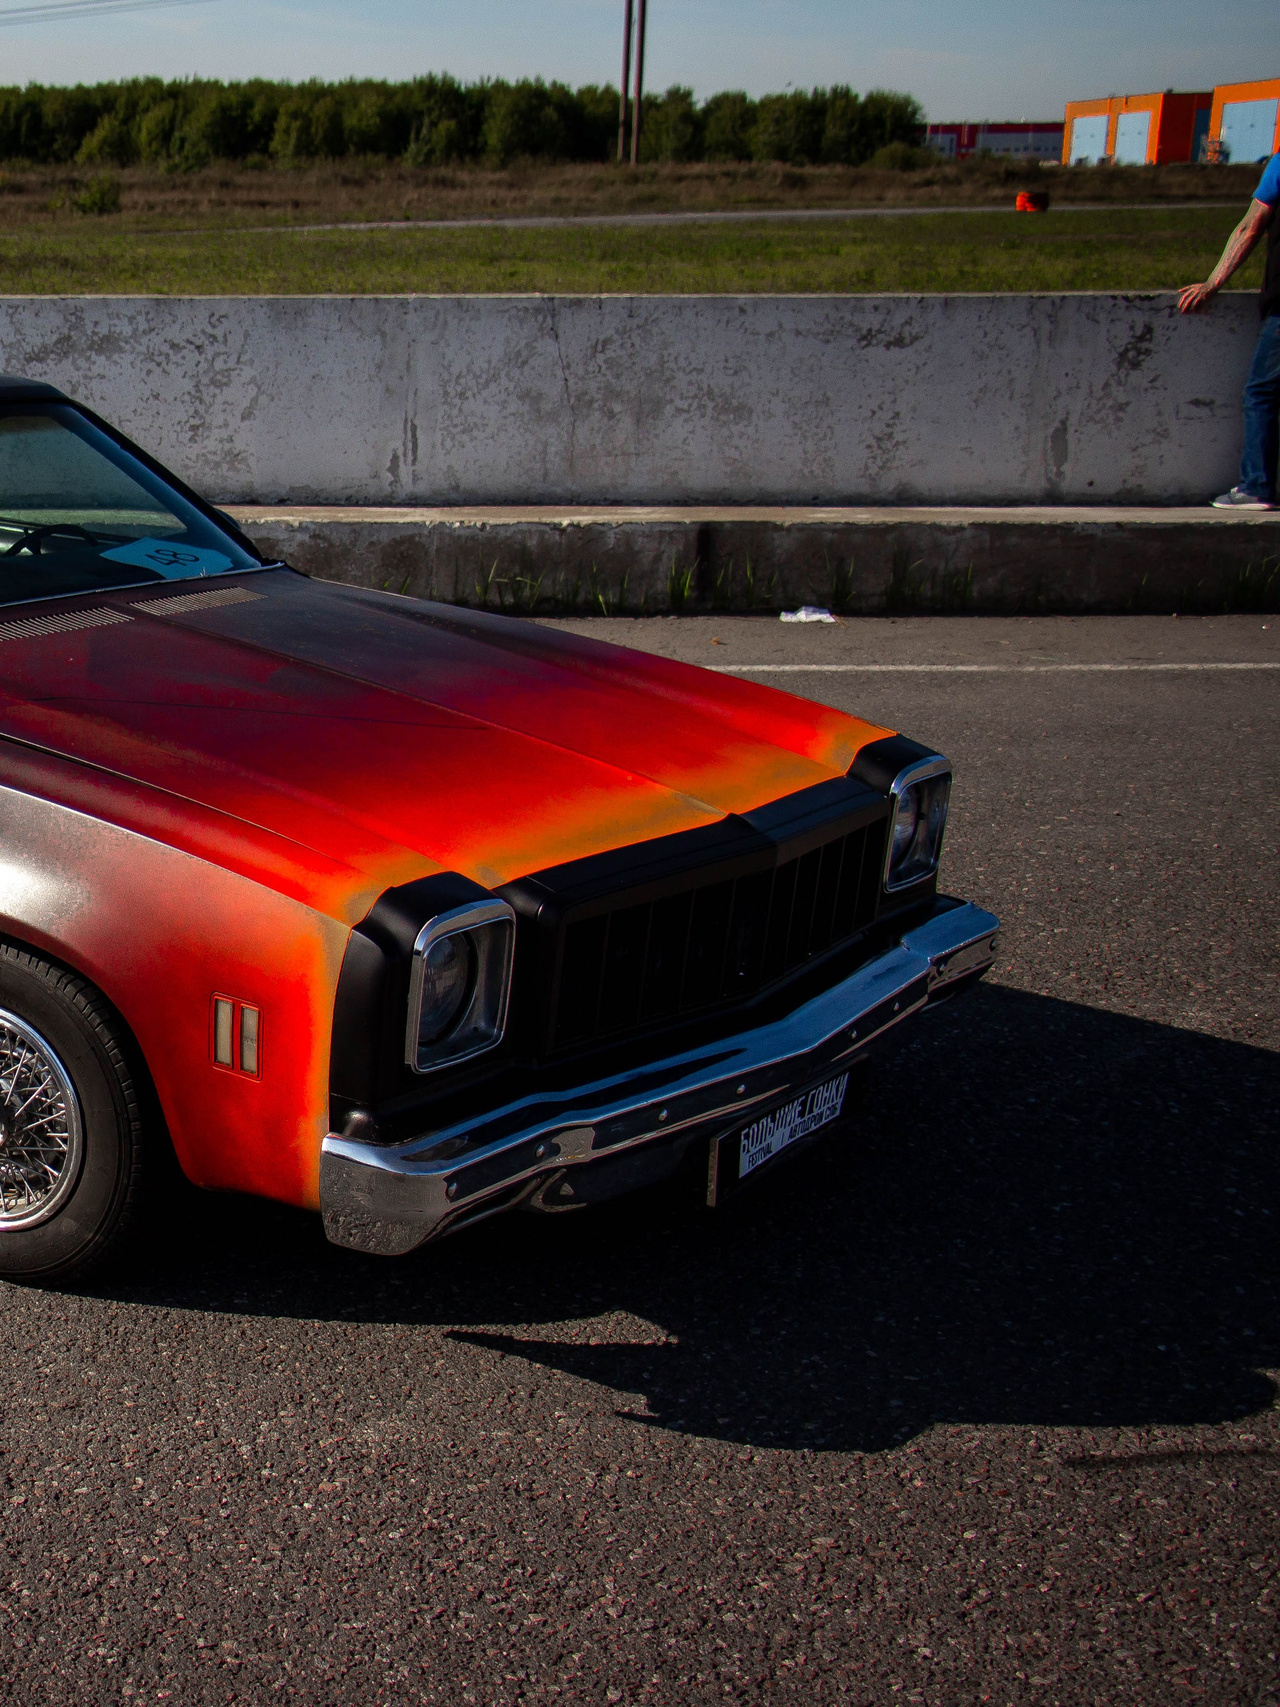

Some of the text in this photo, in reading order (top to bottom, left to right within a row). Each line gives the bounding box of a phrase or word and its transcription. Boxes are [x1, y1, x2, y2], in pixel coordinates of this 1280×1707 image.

[144, 548, 200, 567] 48
[741, 1071, 850, 1155] БОЛЬШИЕ ГОНКИ
[748, 1141, 773, 1169] FESTIVAL
